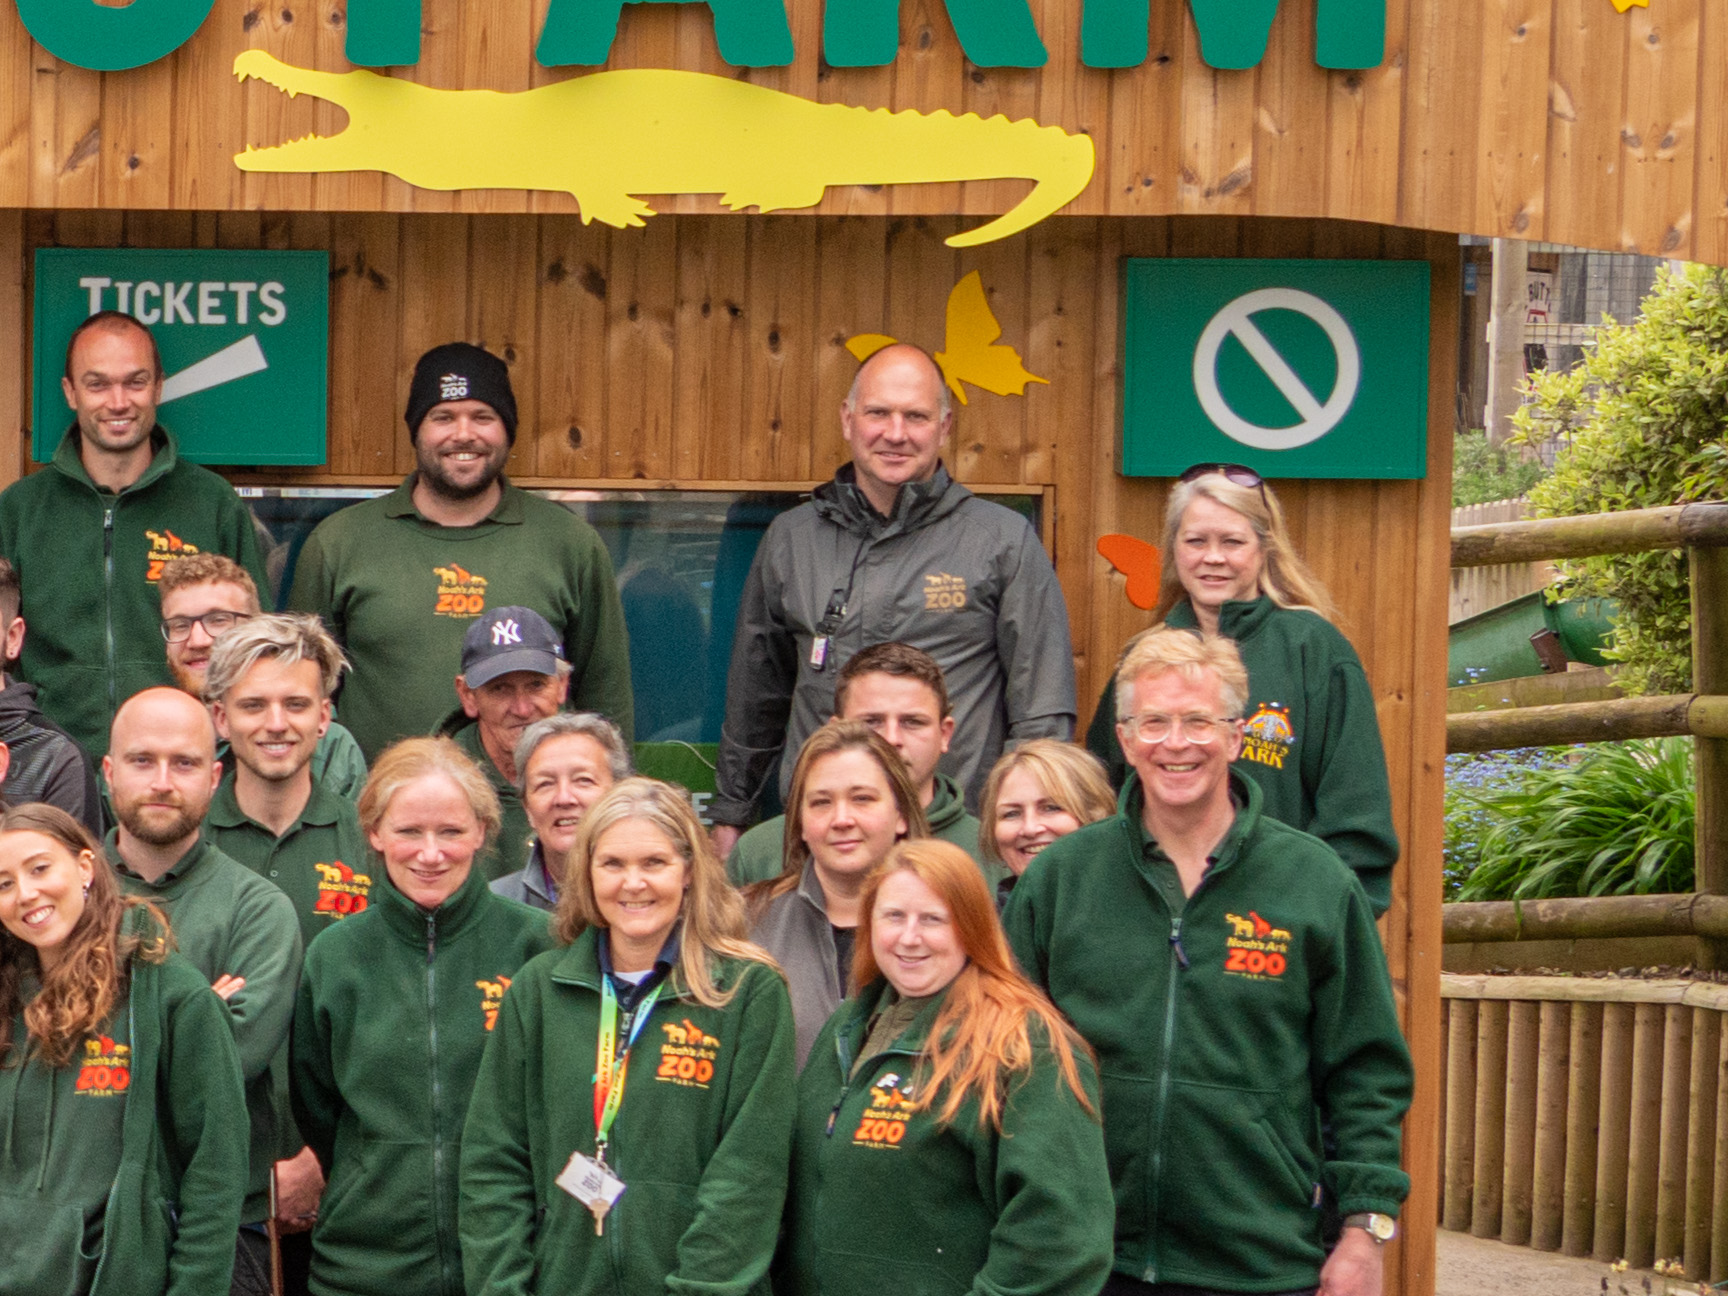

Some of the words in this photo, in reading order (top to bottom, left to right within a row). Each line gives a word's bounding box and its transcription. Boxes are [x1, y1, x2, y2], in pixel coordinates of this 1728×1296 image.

[79, 277, 286, 325] TICKETS
[440, 386, 468, 399] ZOO
[435, 593, 484, 613] ZOO
[925, 591, 966, 610] ZOO
[1240, 745, 1283, 770] ARK
[315, 889, 368, 914] ZOO
[1225, 947, 1286, 976] ZOO
[602, 1031, 610, 1051] Farm
[75, 1065, 130, 1090] ZOO
[657, 1055, 713, 1083] ZOO
[854, 1118, 905, 1144] ZOO
